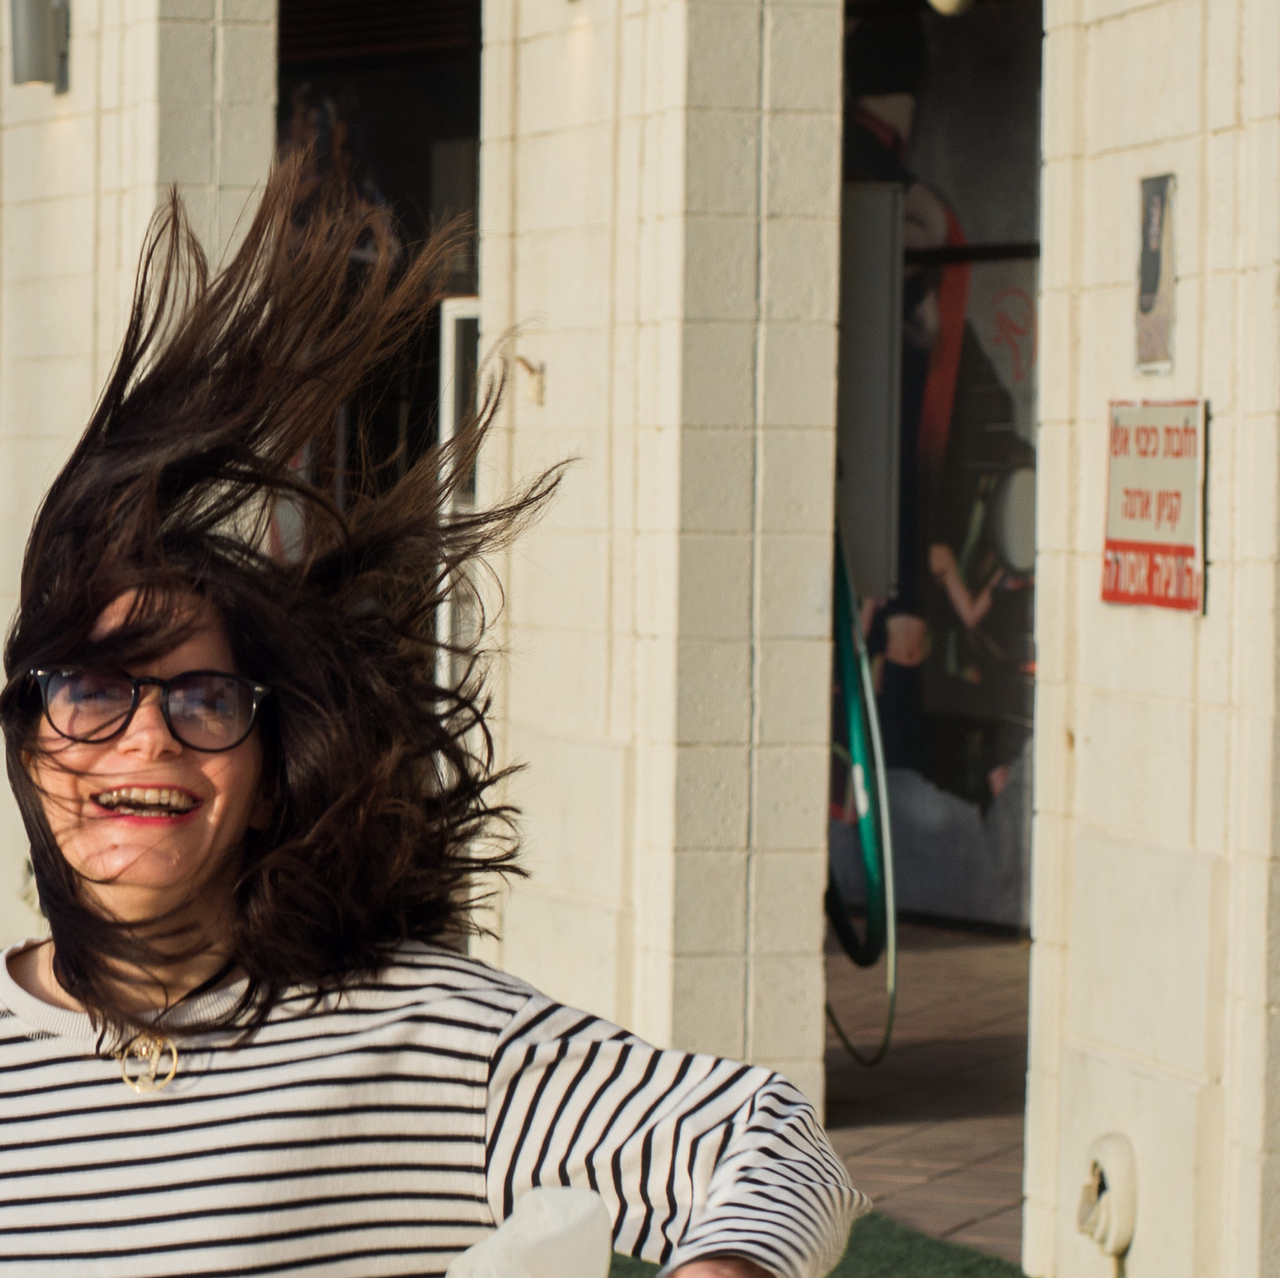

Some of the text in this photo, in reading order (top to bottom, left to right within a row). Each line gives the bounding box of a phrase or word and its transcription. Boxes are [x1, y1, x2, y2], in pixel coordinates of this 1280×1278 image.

[1110, 425, 1131, 457] אש
[1155, 490, 1183, 532] קניון
[1103, 550, 1149, 595] אסורה
